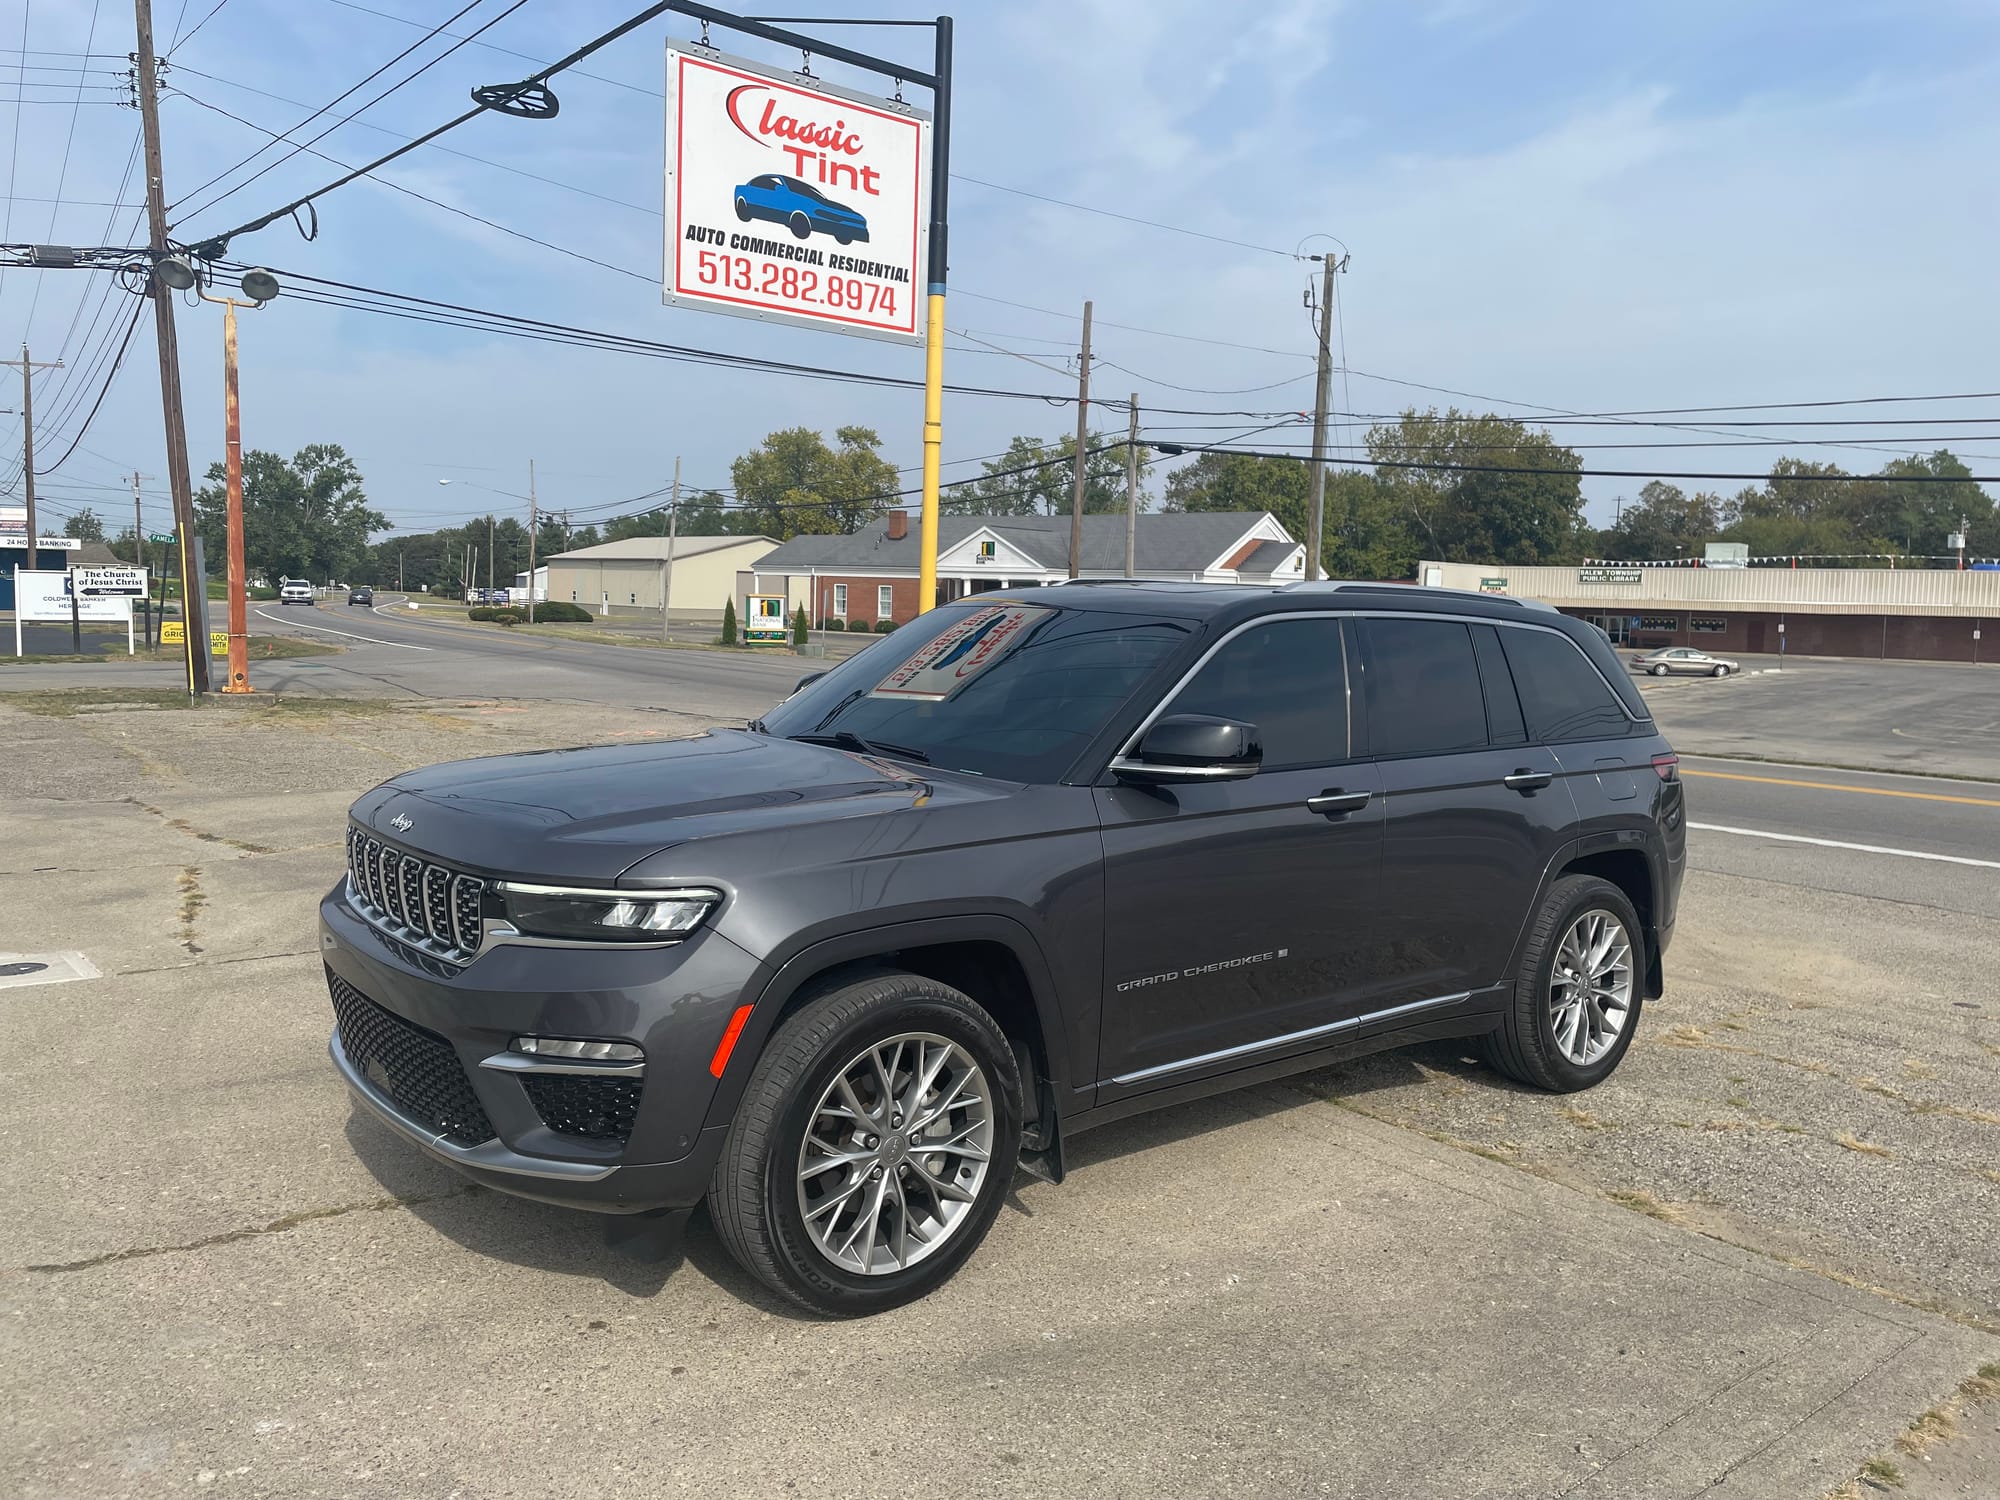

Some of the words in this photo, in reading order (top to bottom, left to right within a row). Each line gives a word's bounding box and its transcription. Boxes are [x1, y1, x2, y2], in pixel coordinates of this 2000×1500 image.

[726, 84, 864, 156] Classic
[782, 144, 880, 197] Tint
[685, 224, 725, 247] AUTO
[730, 233, 824, 267] COMMERCIAL
[828, 253, 910, 284] RESIDENTIAL
[698, 250, 897, 317] 513.282.8974
[152, 534, 175, 543] PAMELA
[78, 578, 89, 586] of
[90, 578, 114, 586] Jesus
[115, 578, 143, 586] Christ
[84, 570, 101, 578] The
[103, 570, 136, 578] Church
[390, 812, 414, 833] Jeep
[1116, 971, 1179, 992] GRAND
[1183, 951, 1274, 978] CHEROKEE
